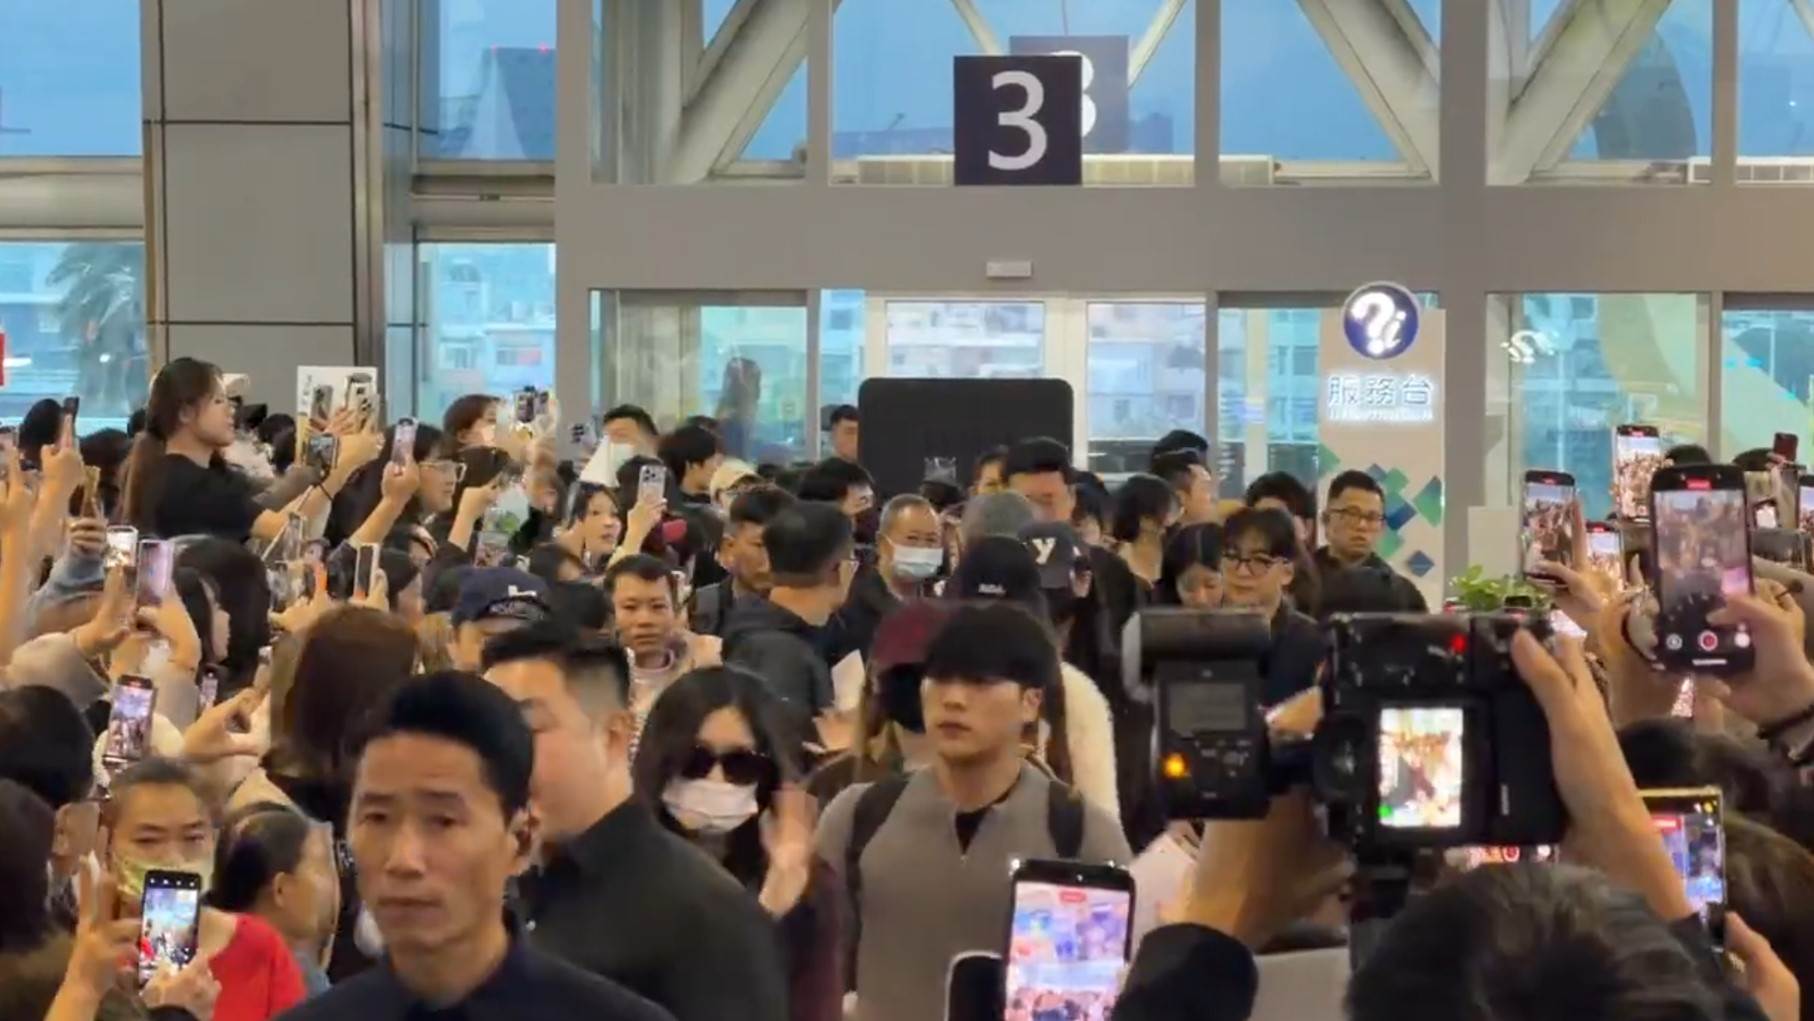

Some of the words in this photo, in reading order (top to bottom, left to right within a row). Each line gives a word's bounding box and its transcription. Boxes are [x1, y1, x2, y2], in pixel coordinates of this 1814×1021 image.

[988, 70, 1047, 171] 3
[1328, 374, 1431, 406] 服務台
